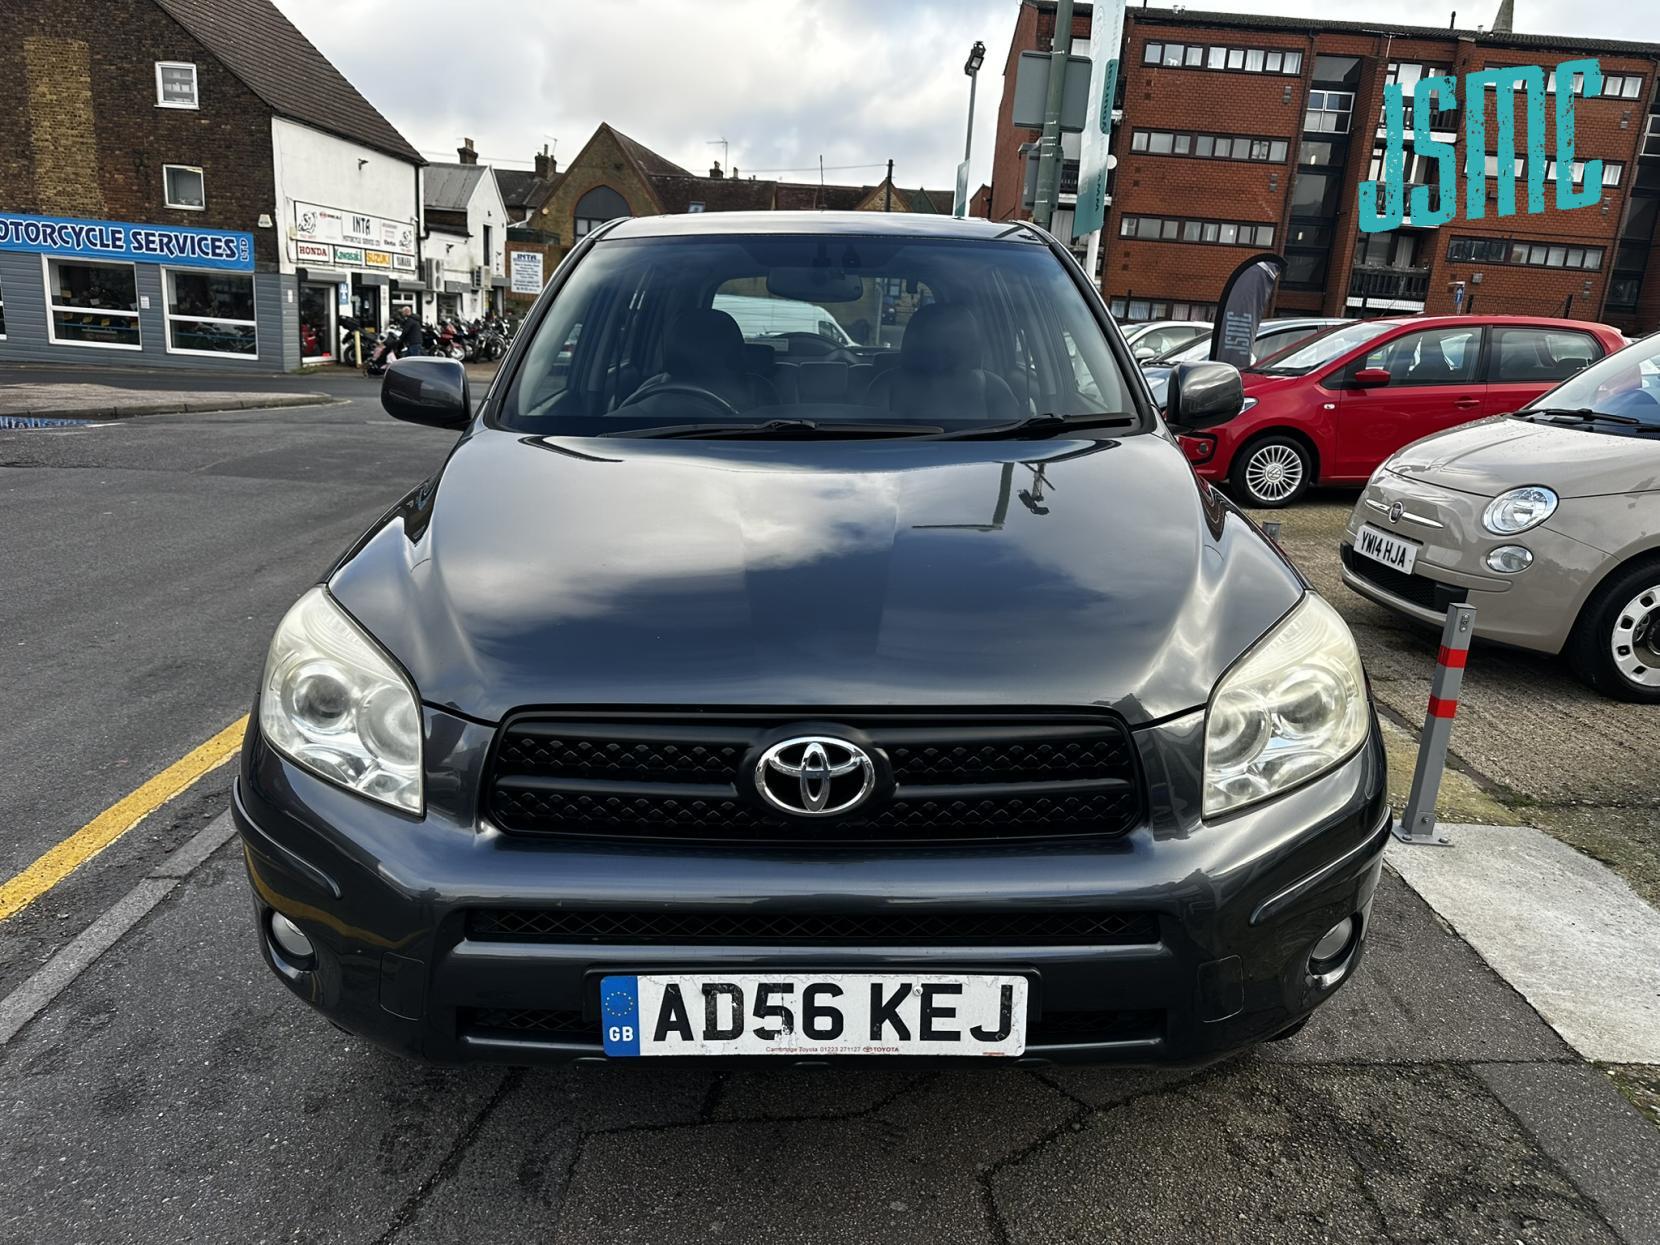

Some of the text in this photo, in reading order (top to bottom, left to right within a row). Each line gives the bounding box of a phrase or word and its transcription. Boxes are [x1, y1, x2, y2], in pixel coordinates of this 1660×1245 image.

[352, 215, 370, 236] INTA
[130, 229, 238, 262] SERVICES
[240, 238, 249, 262] LTD
[299, 245, 327, 257] HONDA
[335, 248, 362, 262] Kawasaki
[367, 252, 391, 265] SUZUKI
[1224, 311, 1252, 355] JSMC
[1382, 540, 1407, 568] HJA
[653, 982, 1014, 1042] AD56 KEJ
[608, 1026, 634, 1042] GB
[765, 1046, 798, 1054] Cambridge
[799, 1046, 818, 1055] Toyota
